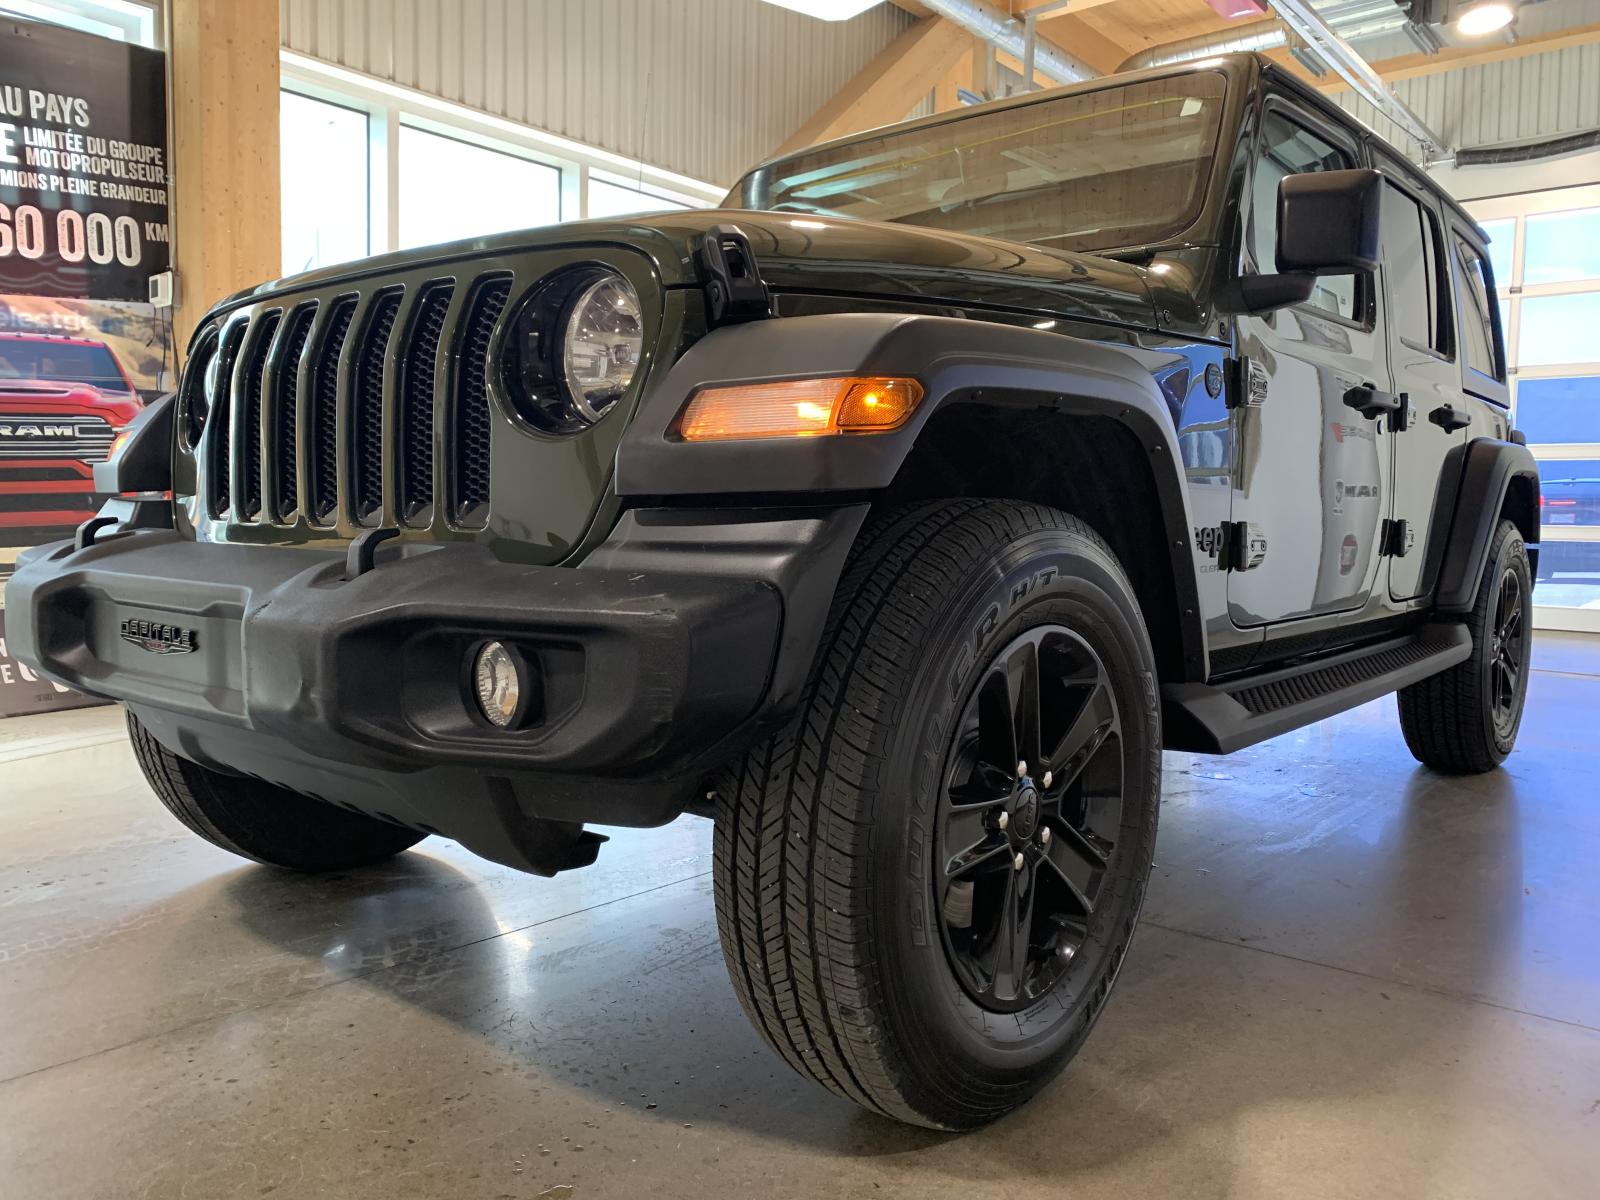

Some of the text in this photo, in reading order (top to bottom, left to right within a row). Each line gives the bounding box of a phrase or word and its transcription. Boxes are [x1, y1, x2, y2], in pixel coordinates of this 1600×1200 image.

[29, 89, 90, 128] PAYS
[24, 126, 85, 153] LIMITÉE
[87, 136, 107, 156] DU
[109, 140, 164, 165] GROUPE
[25, 146, 165, 184] MOTOPROPULSEUR
[50, 174, 99, 197] PLEINE
[100, 182, 167, 206] GRANDEUR
[56, 209, 142, 267] 000
[144, 222, 169, 243] KM
[1009, 565, 1060, 609] H/T
